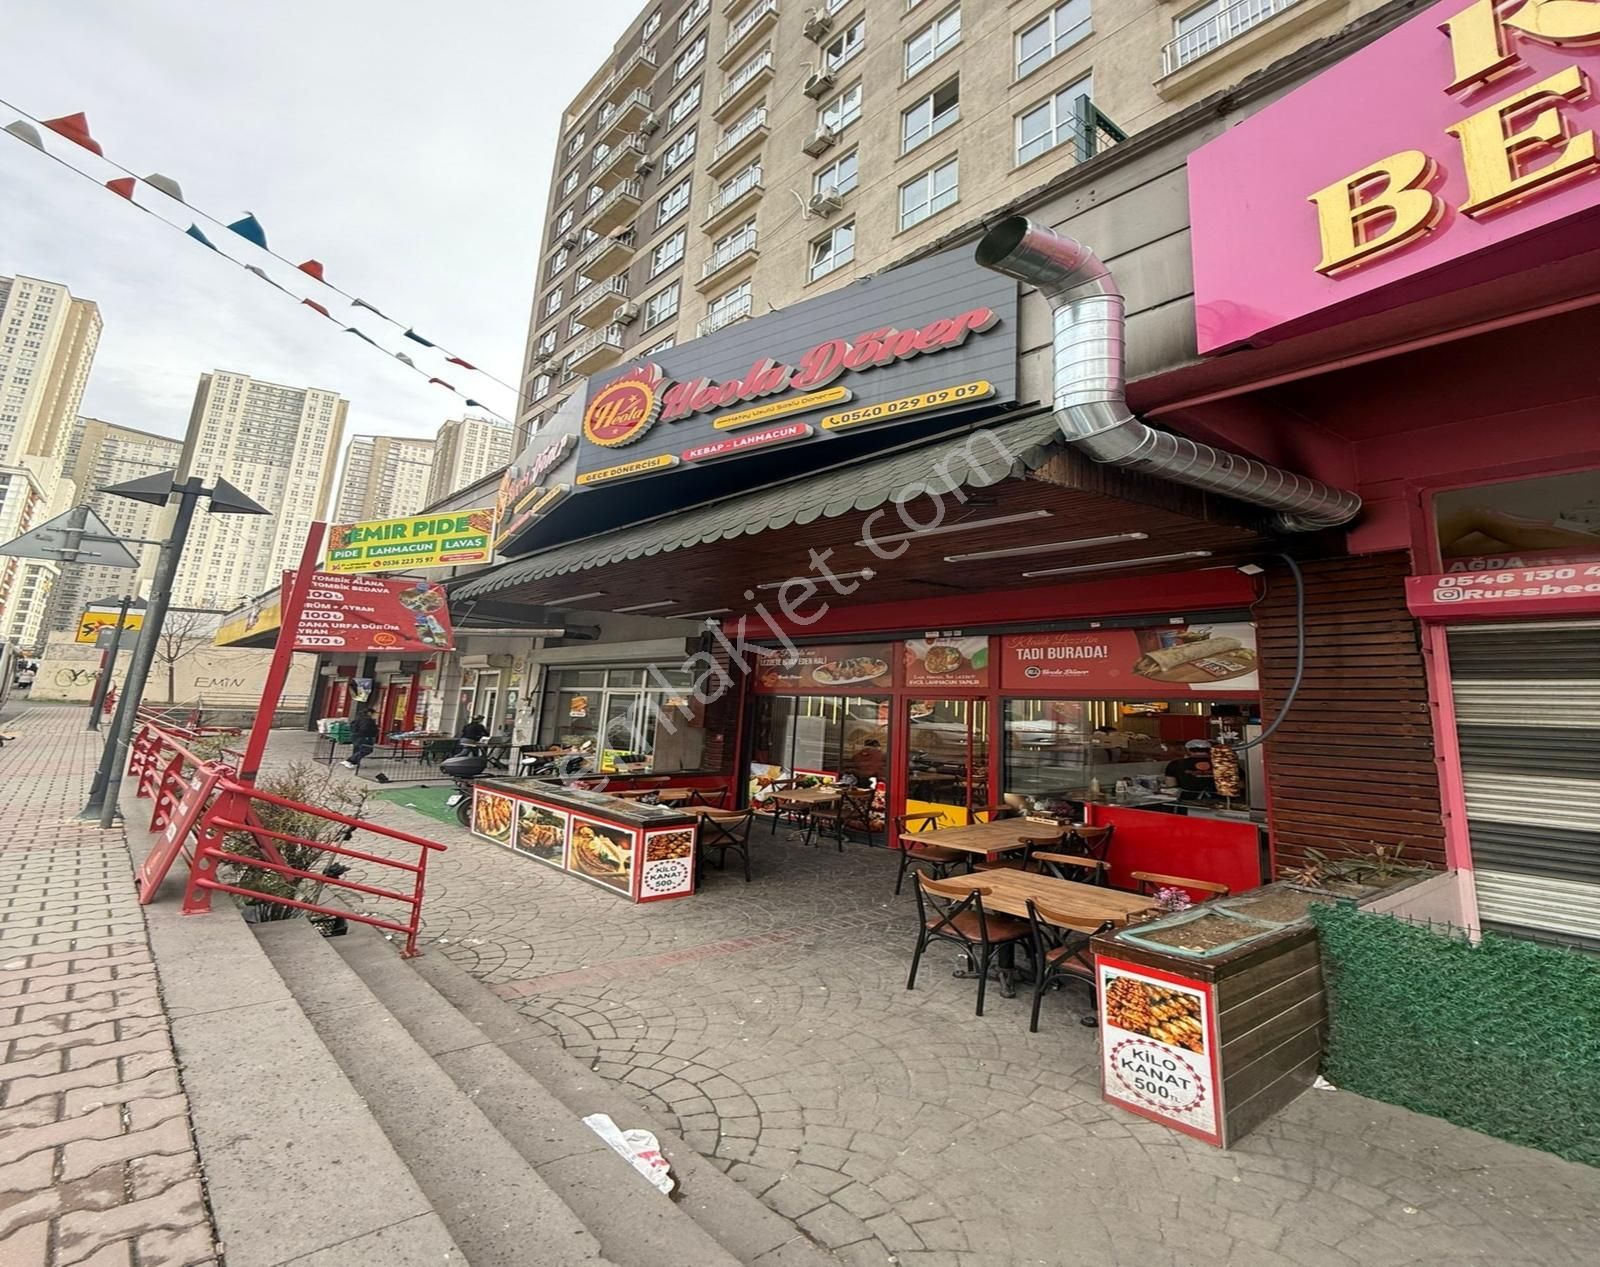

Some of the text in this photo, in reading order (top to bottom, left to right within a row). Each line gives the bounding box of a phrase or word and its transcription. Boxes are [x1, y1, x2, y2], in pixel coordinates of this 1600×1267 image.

[660, 306, 997, 422] Heola Döner
[592, 397, 644, 431] Heola
[841, 385, 979, 423] 0540 029 09 09
[690, 443, 723, 457] KEBAP
[733, 427, 797, 448] LAHMACUN
[586, 458, 661, 481] GECE DÖNERCİSİ
[370, 543, 434, 556] LAHMACUN
[445, 538, 482, 548] LAVAŞ
[1448, 556, 1525, 573] AĞDA
[351, 585, 390, 594] BEDAVA
[1438, 573, 1514, 588] 0546
[1523, 568, 1576, 582] 130
[1016, 645, 1108, 660] TADI BURADA!
[650, 871, 682, 881] KANAT
[1132, 1048, 1177, 1072] KİLO
[1121, 1057, 1192, 1090] KANAT
